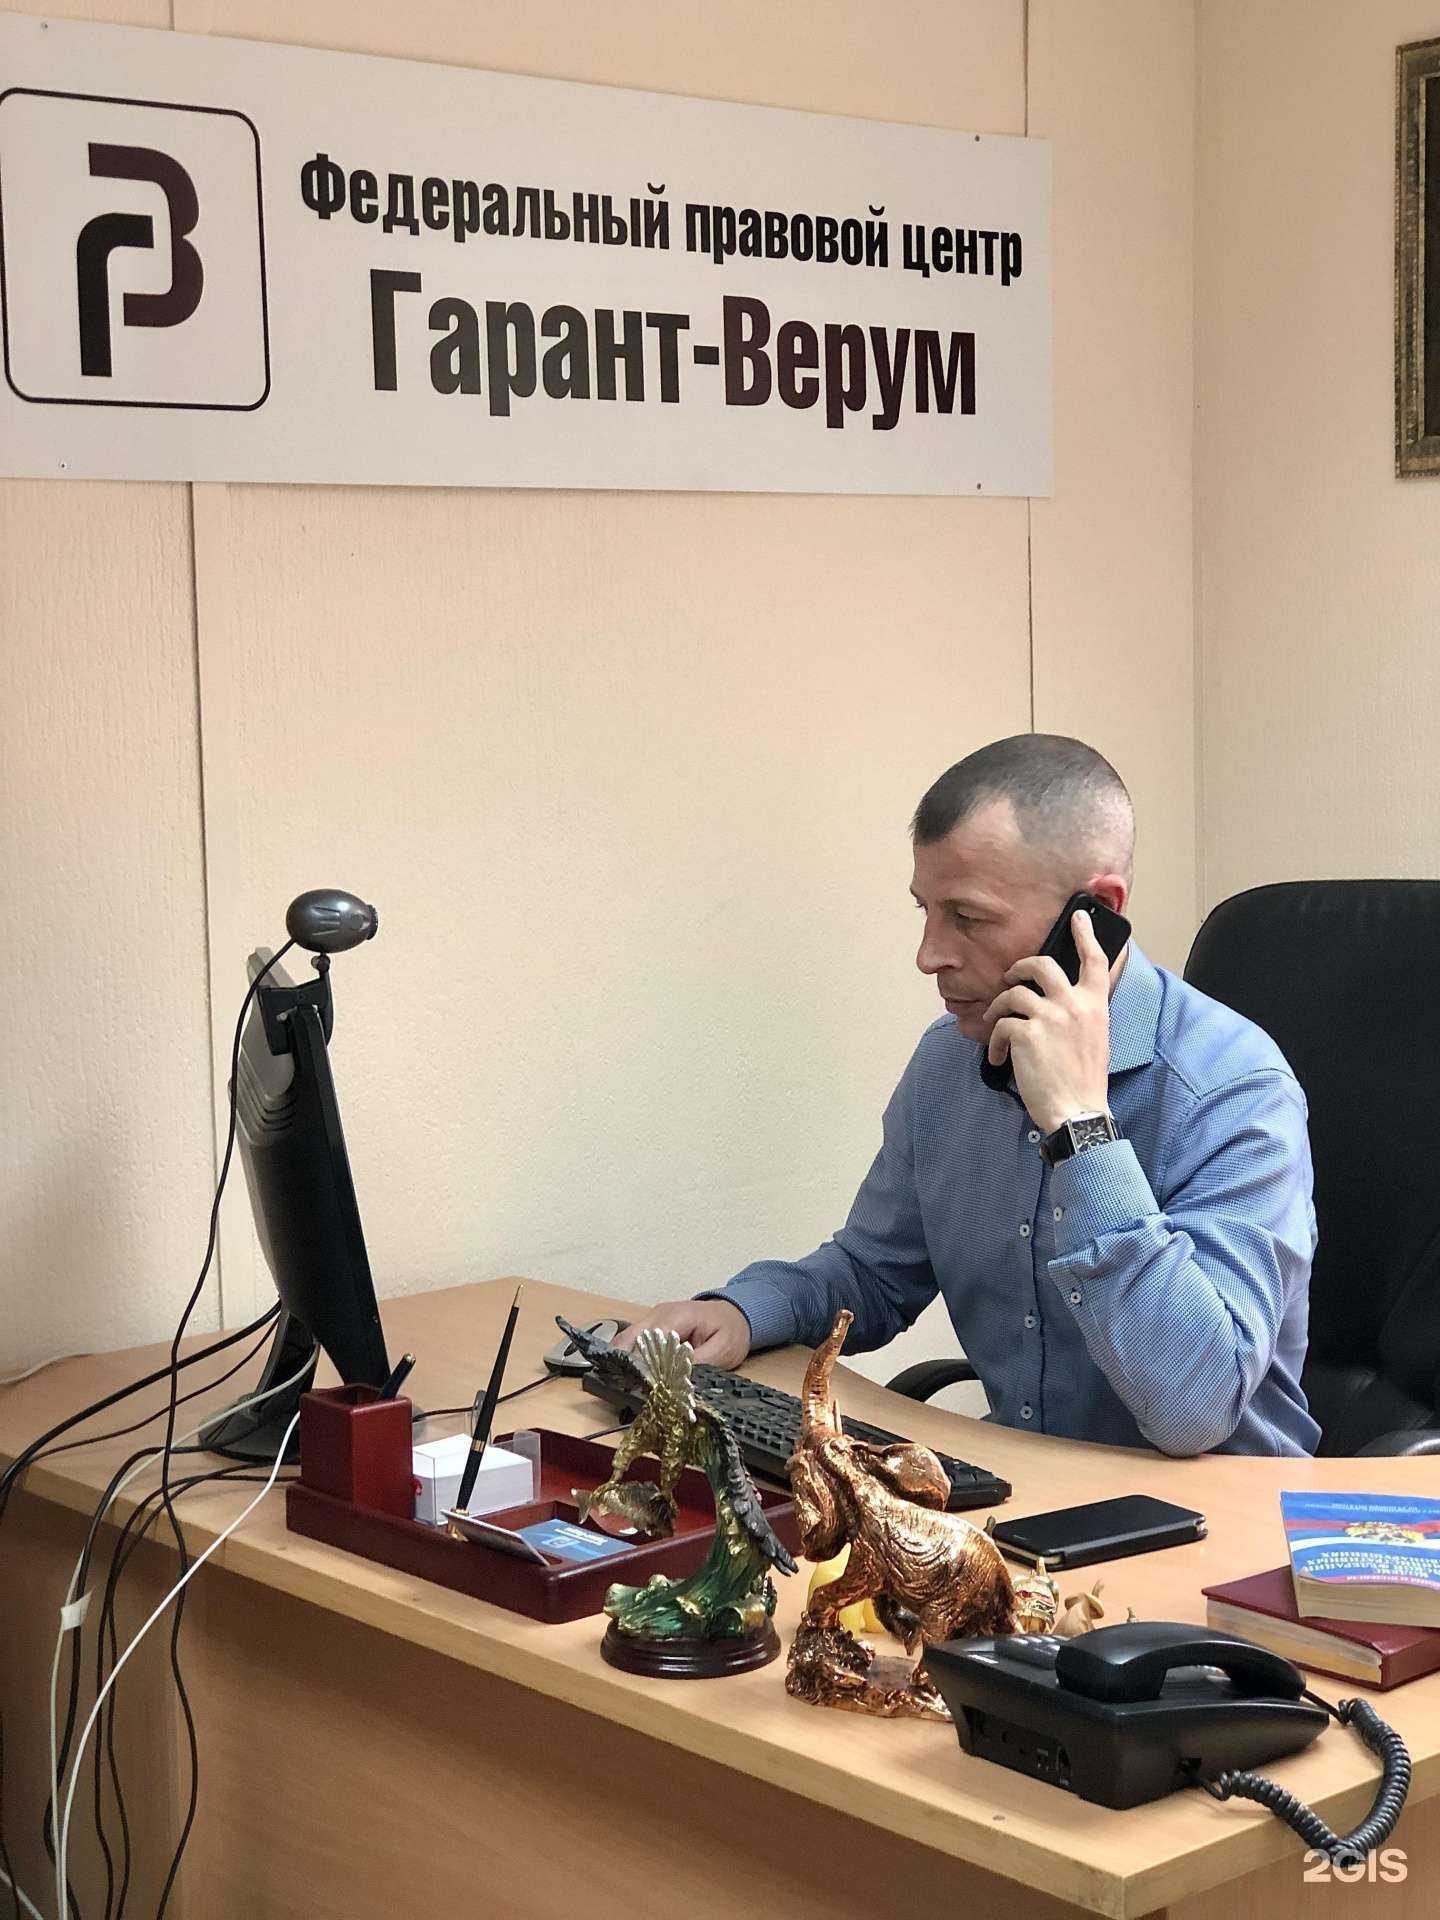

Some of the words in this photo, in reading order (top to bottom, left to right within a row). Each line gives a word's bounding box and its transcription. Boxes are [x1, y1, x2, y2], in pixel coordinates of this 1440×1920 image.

[300, 152, 670, 251] Федеральный
[685, 203, 890, 268] правовой
[902, 223, 1023, 287] центр
[369, 268, 976, 431] Гарант-Верум
